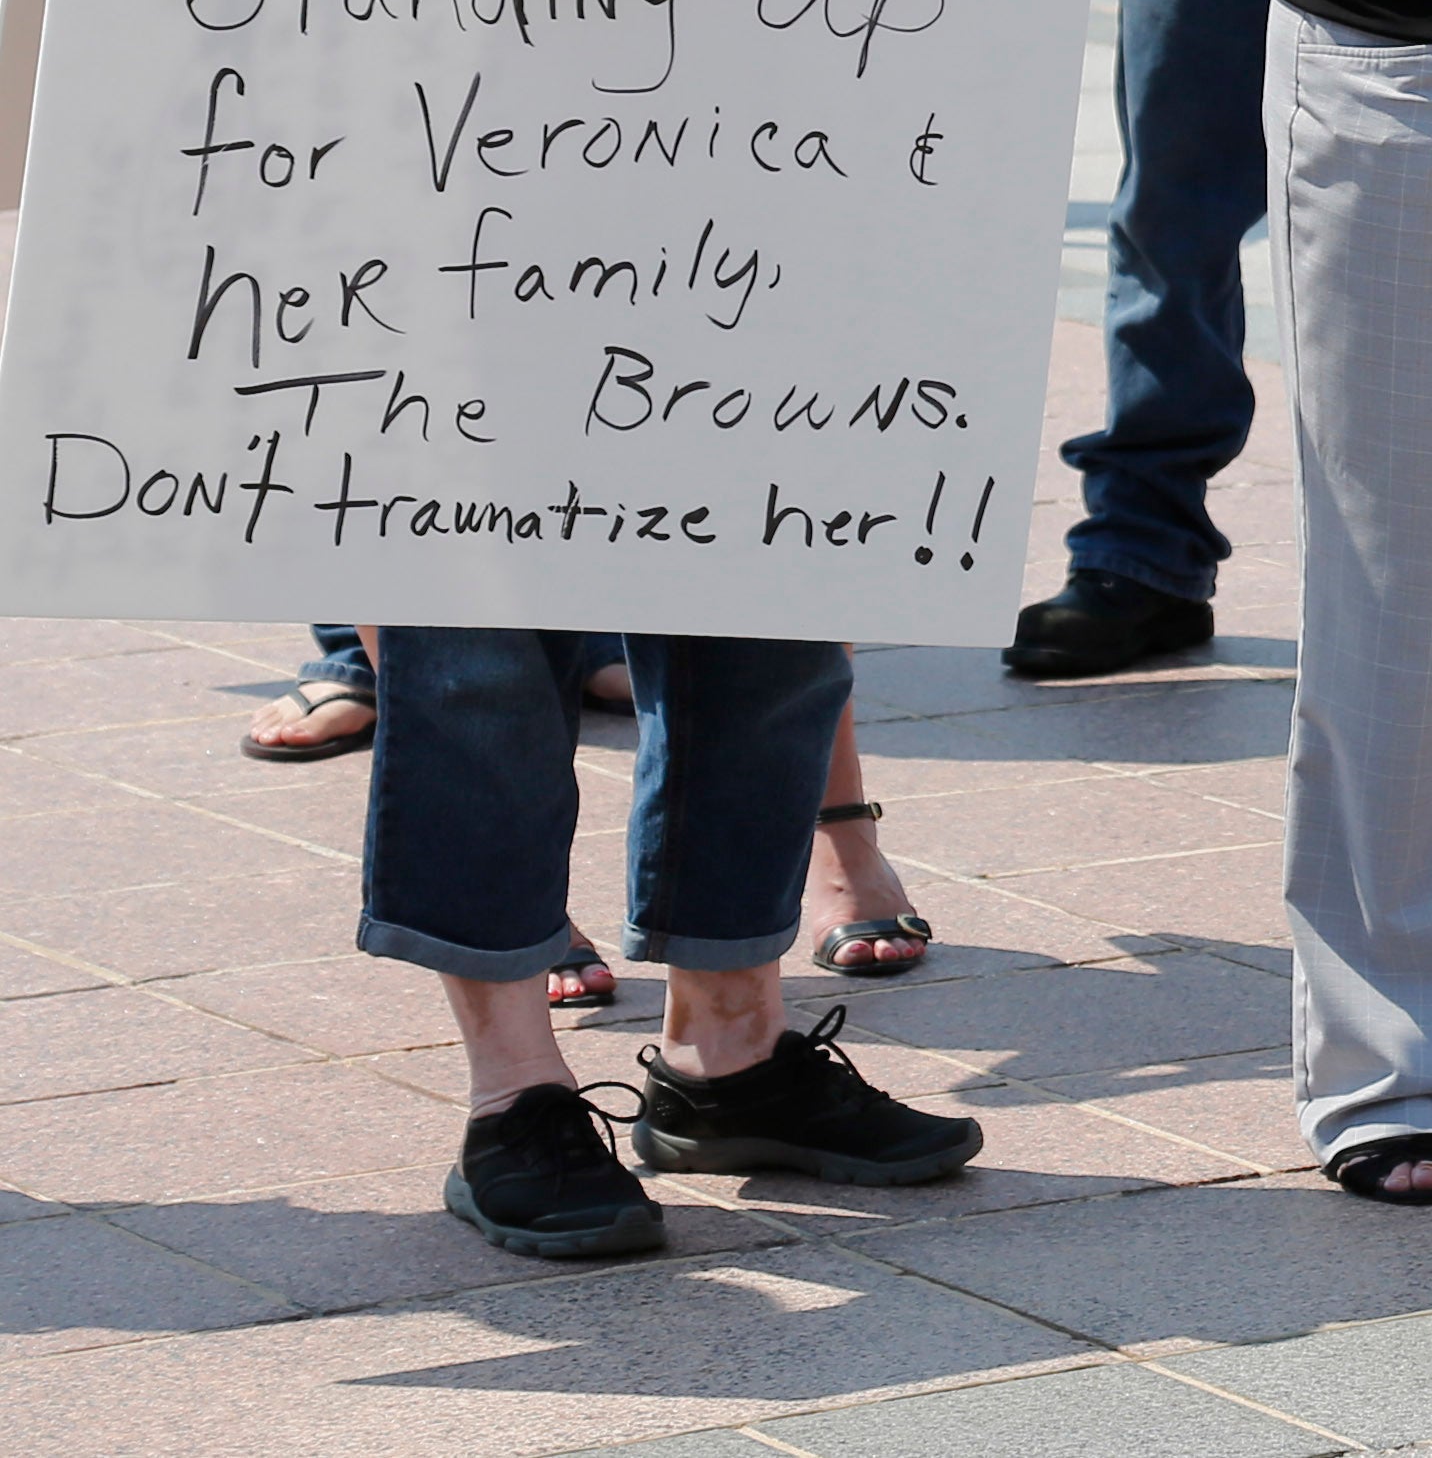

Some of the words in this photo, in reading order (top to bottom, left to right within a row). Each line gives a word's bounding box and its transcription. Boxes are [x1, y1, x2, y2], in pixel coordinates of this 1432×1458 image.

[181, 68, 343, 216] for
[438, 207, 780, 329] family,
[234, 370, 495, 442] The
[314, 453, 716, 546] traumatize
[763, 471, 995, 571] her!!
